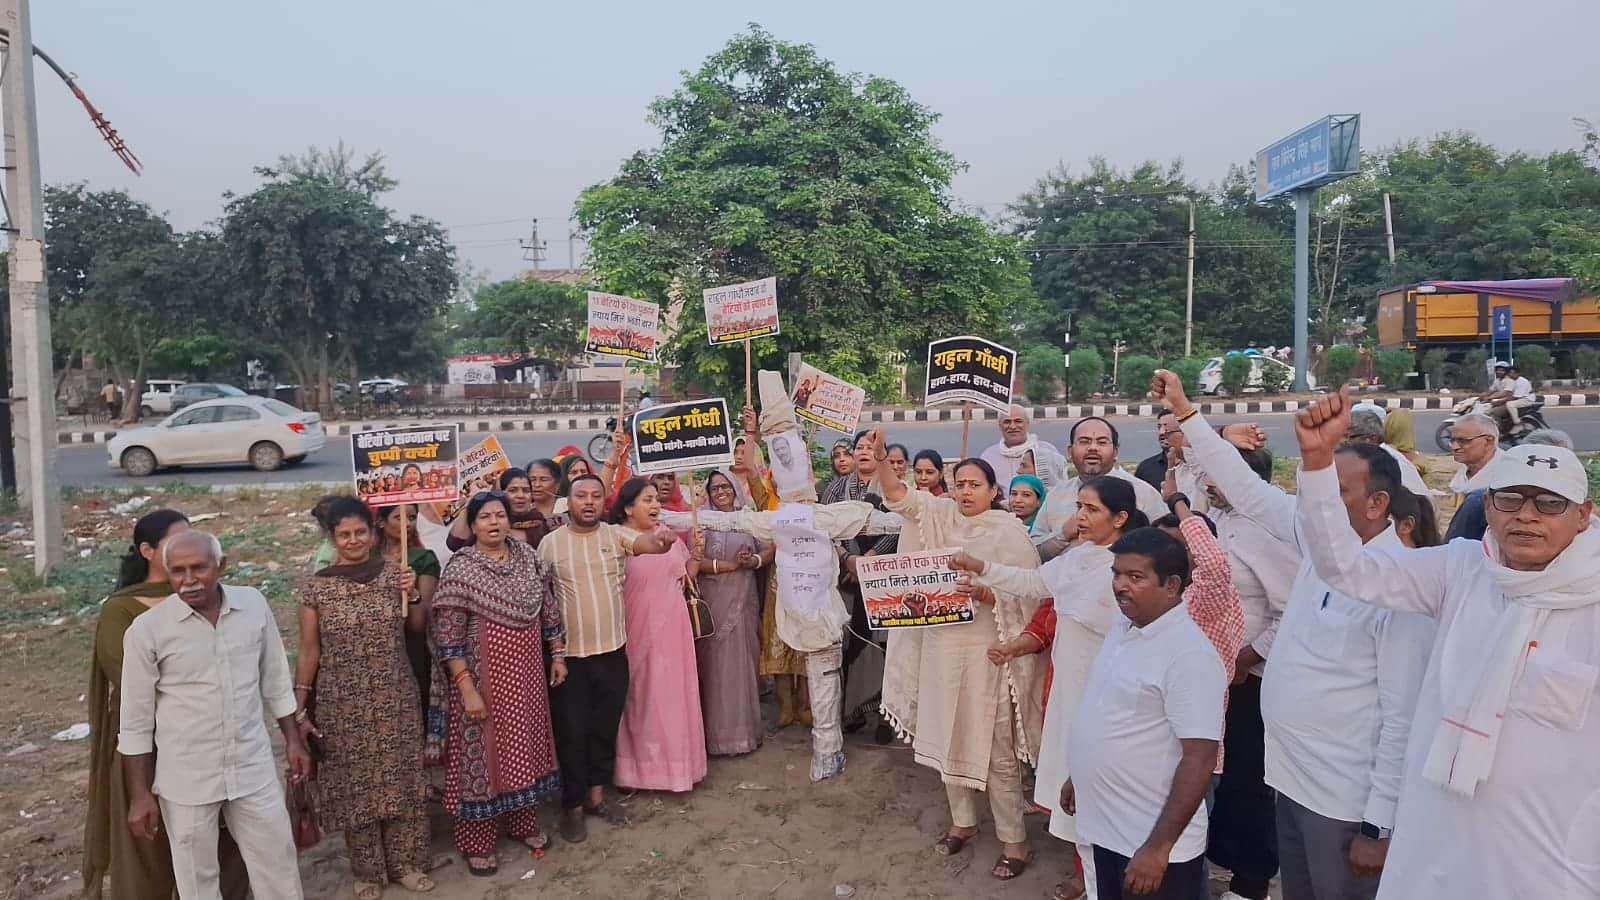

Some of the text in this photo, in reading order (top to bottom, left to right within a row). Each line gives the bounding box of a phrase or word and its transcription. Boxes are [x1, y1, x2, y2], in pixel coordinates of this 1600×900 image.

[708, 292, 726, 304] राहुल
[934, 347, 1009, 375] राहुल गाँधी
[640, 407, 721, 440] राहुल गाँधी
[357, 433, 382, 449] बेटियों
[383, 432, 394, 446] के
[434, 430, 450, 443] पर
[367, 443, 441, 467] चुप्पी क्यों
[862, 555, 952, 573] 11 बेटियों की एक पुका
[864, 578, 886, 589] न्याय
[889, 574, 909, 587] मिले
[912, 571, 939, 585] अबकी
